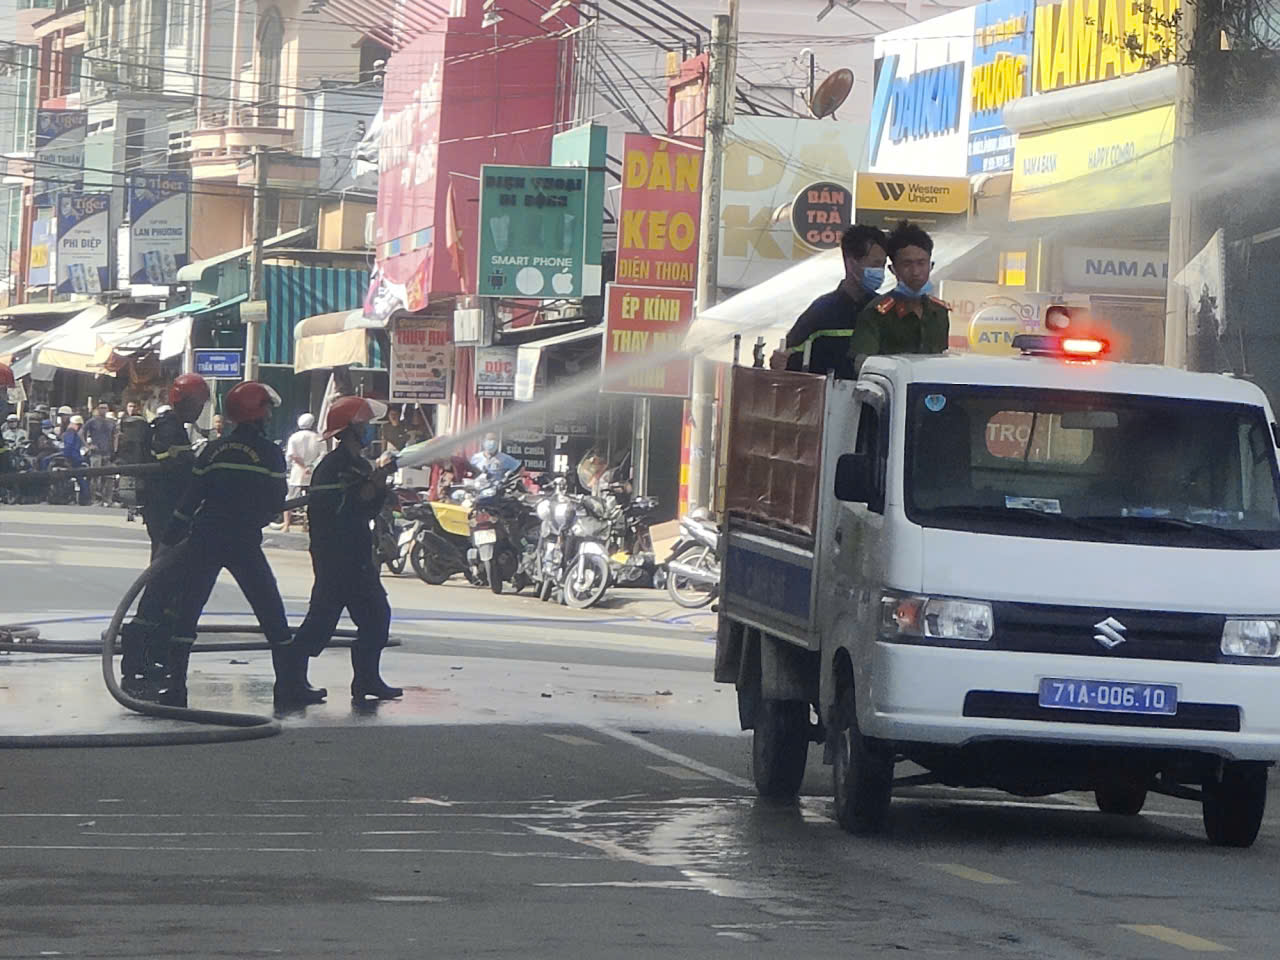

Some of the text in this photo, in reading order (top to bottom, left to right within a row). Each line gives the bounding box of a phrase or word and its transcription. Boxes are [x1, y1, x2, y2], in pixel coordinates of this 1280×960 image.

[889, 61, 964, 144] DAIKIN
[626, 141, 701, 192] DÁN
[807, 187, 845, 205] BÁN
[908, 184, 950, 195] Western
[908, 194, 938, 203] Union
[74, 198, 107, 214] Tiger
[807, 207, 841, 224] TRẢ
[622, 209, 696, 252] KEO
[63, 239, 77, 249] PHI
[491, 256, 573, 267] SMART PHONE
[620, 257, 693, 285] ĐIỆN THOẠI
[1085, 258, 1138, 278] NAM
[1142, 262, 1157, 278] A
[622, 292, 681, 322] ÉP KÍNH
[612, 329, 649, 353] THAY
[978, 331, 1018, 344] ATM
[1052, 682, 1166, 709] 71A-006.10
